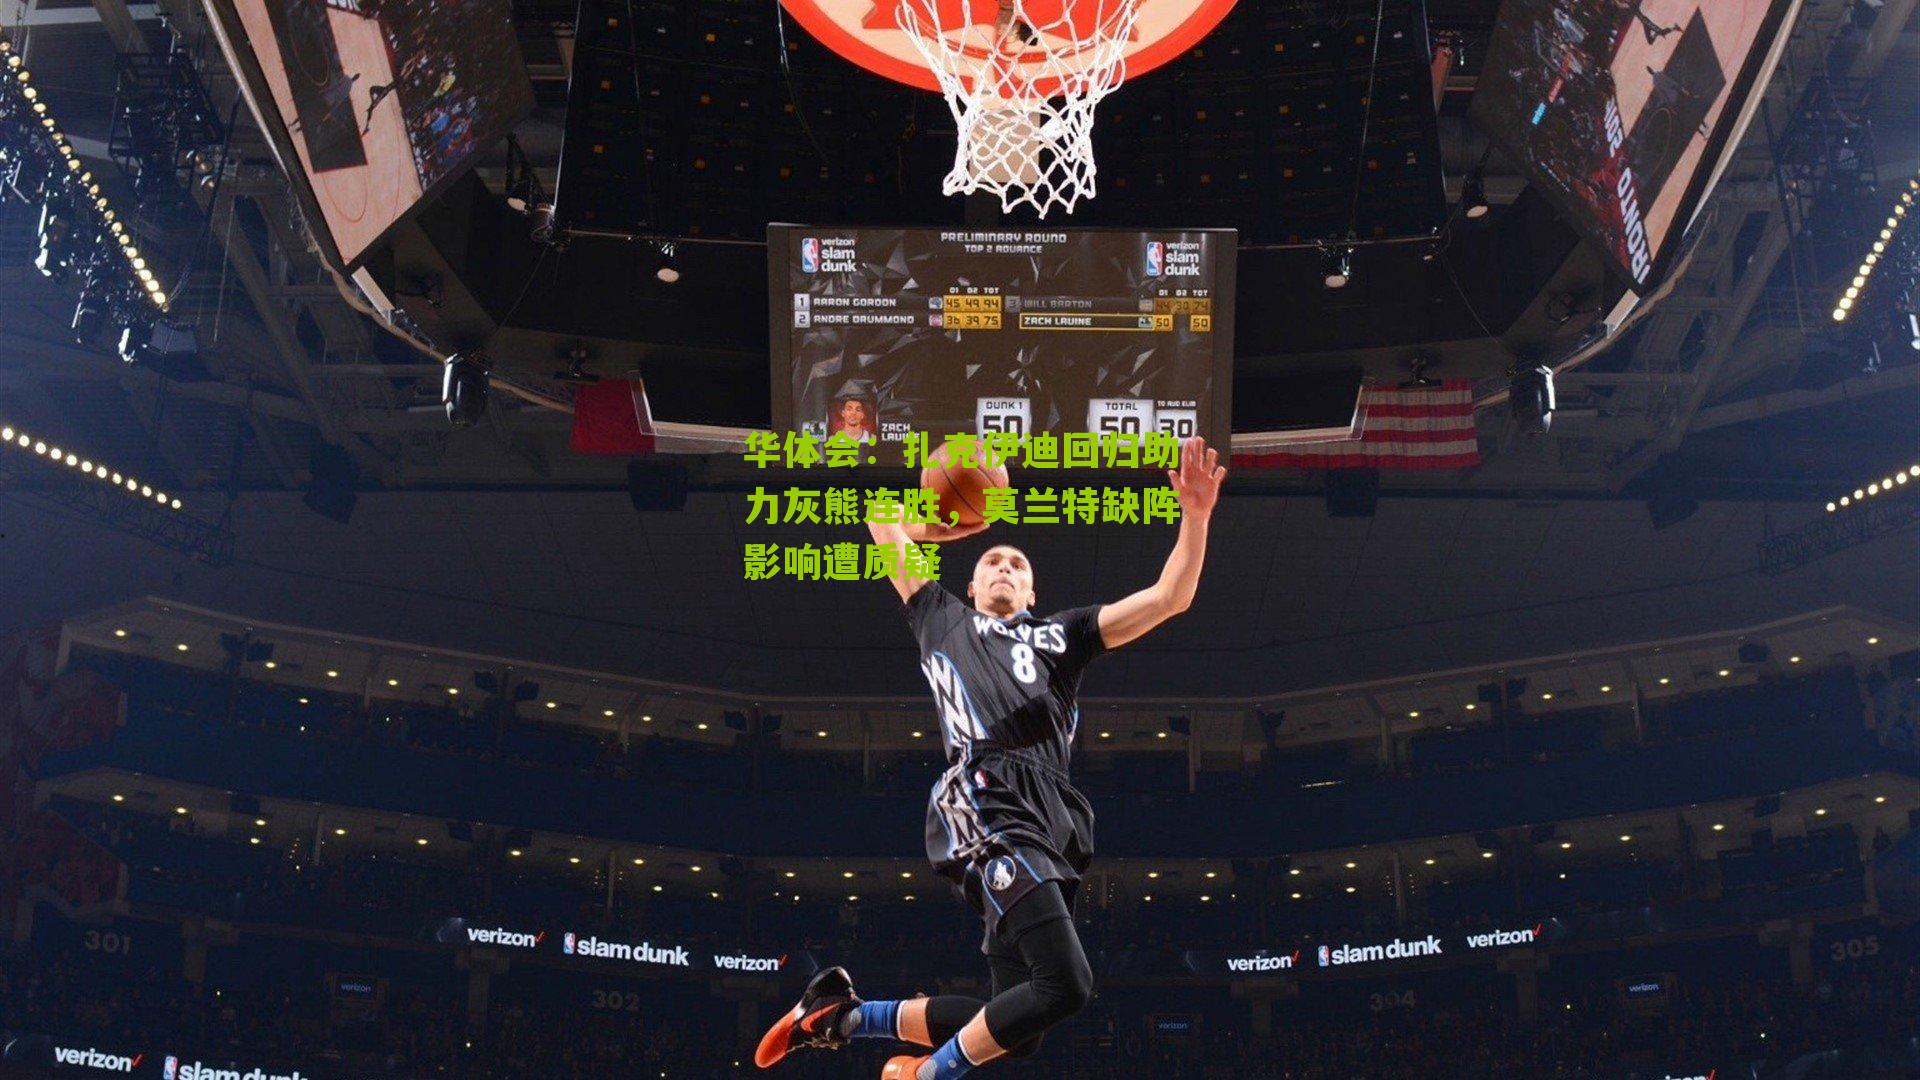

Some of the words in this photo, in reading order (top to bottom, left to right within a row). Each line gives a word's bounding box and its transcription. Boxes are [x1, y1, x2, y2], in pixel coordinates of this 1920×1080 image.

[821, 237, 855, 246] verizon
[941, 232, 1021, 242] PRELIMINARY
[1025, 233, 1067, 243] ROUND
[965, 244, 984, 253] TOP
[986, 244, 993, 253] 2
[1165, 241, 1200, 250] verizon
[821, 246, 855, 259] slam
[1165, 250, 1200, 263] slam
[821, 259, 857, 272] dunk
[1165, 263, 1200, 276] dunk
[813, 298, 850, 306] AARON
[853, 298, 897, 307] GORDON
[946, 299, 960, 308] 45
[965, 299, 979, 308] 49
[984, 299, 999, 308] 94
[813, 315, 850, 323] ANDRE
[852, 315, 914, 324] DRUMMOND
[947, 316, 960, 325] 36
[966, 316, 979, 325] 39
[984, 316, 998, 325] 75
[1024, 317, 1052, 325] ZACH
[1156, 318, 1170, 327] 50
[1193, 318, 1208, 327] 50
[986, 401, 1015, 409] DUNK
[1105, 402, 1138, 411] TOTAL
[881, 423, 911, 432] ZACH
[983, 415, 1023, 439] 50
[1100, 416, 1140, 440] 50
[1160, 418, 1193, 438] 30
[973, 615, 1067, 653] WOLVES
[1011, 643, 1037, 683] 8
[84, 930, 132, 955] 301
[467, 927, 536, 948] verizon
[1466, 927, 1534, 948] verizon
[1830, 935, 1880, 960] 305
[714, 953, 779, 971] verizon
[1227, 953, 1292, 971] verizon
[591, 988, 641, 1012] 302
[55, 1047, 132, 1072] verizon
